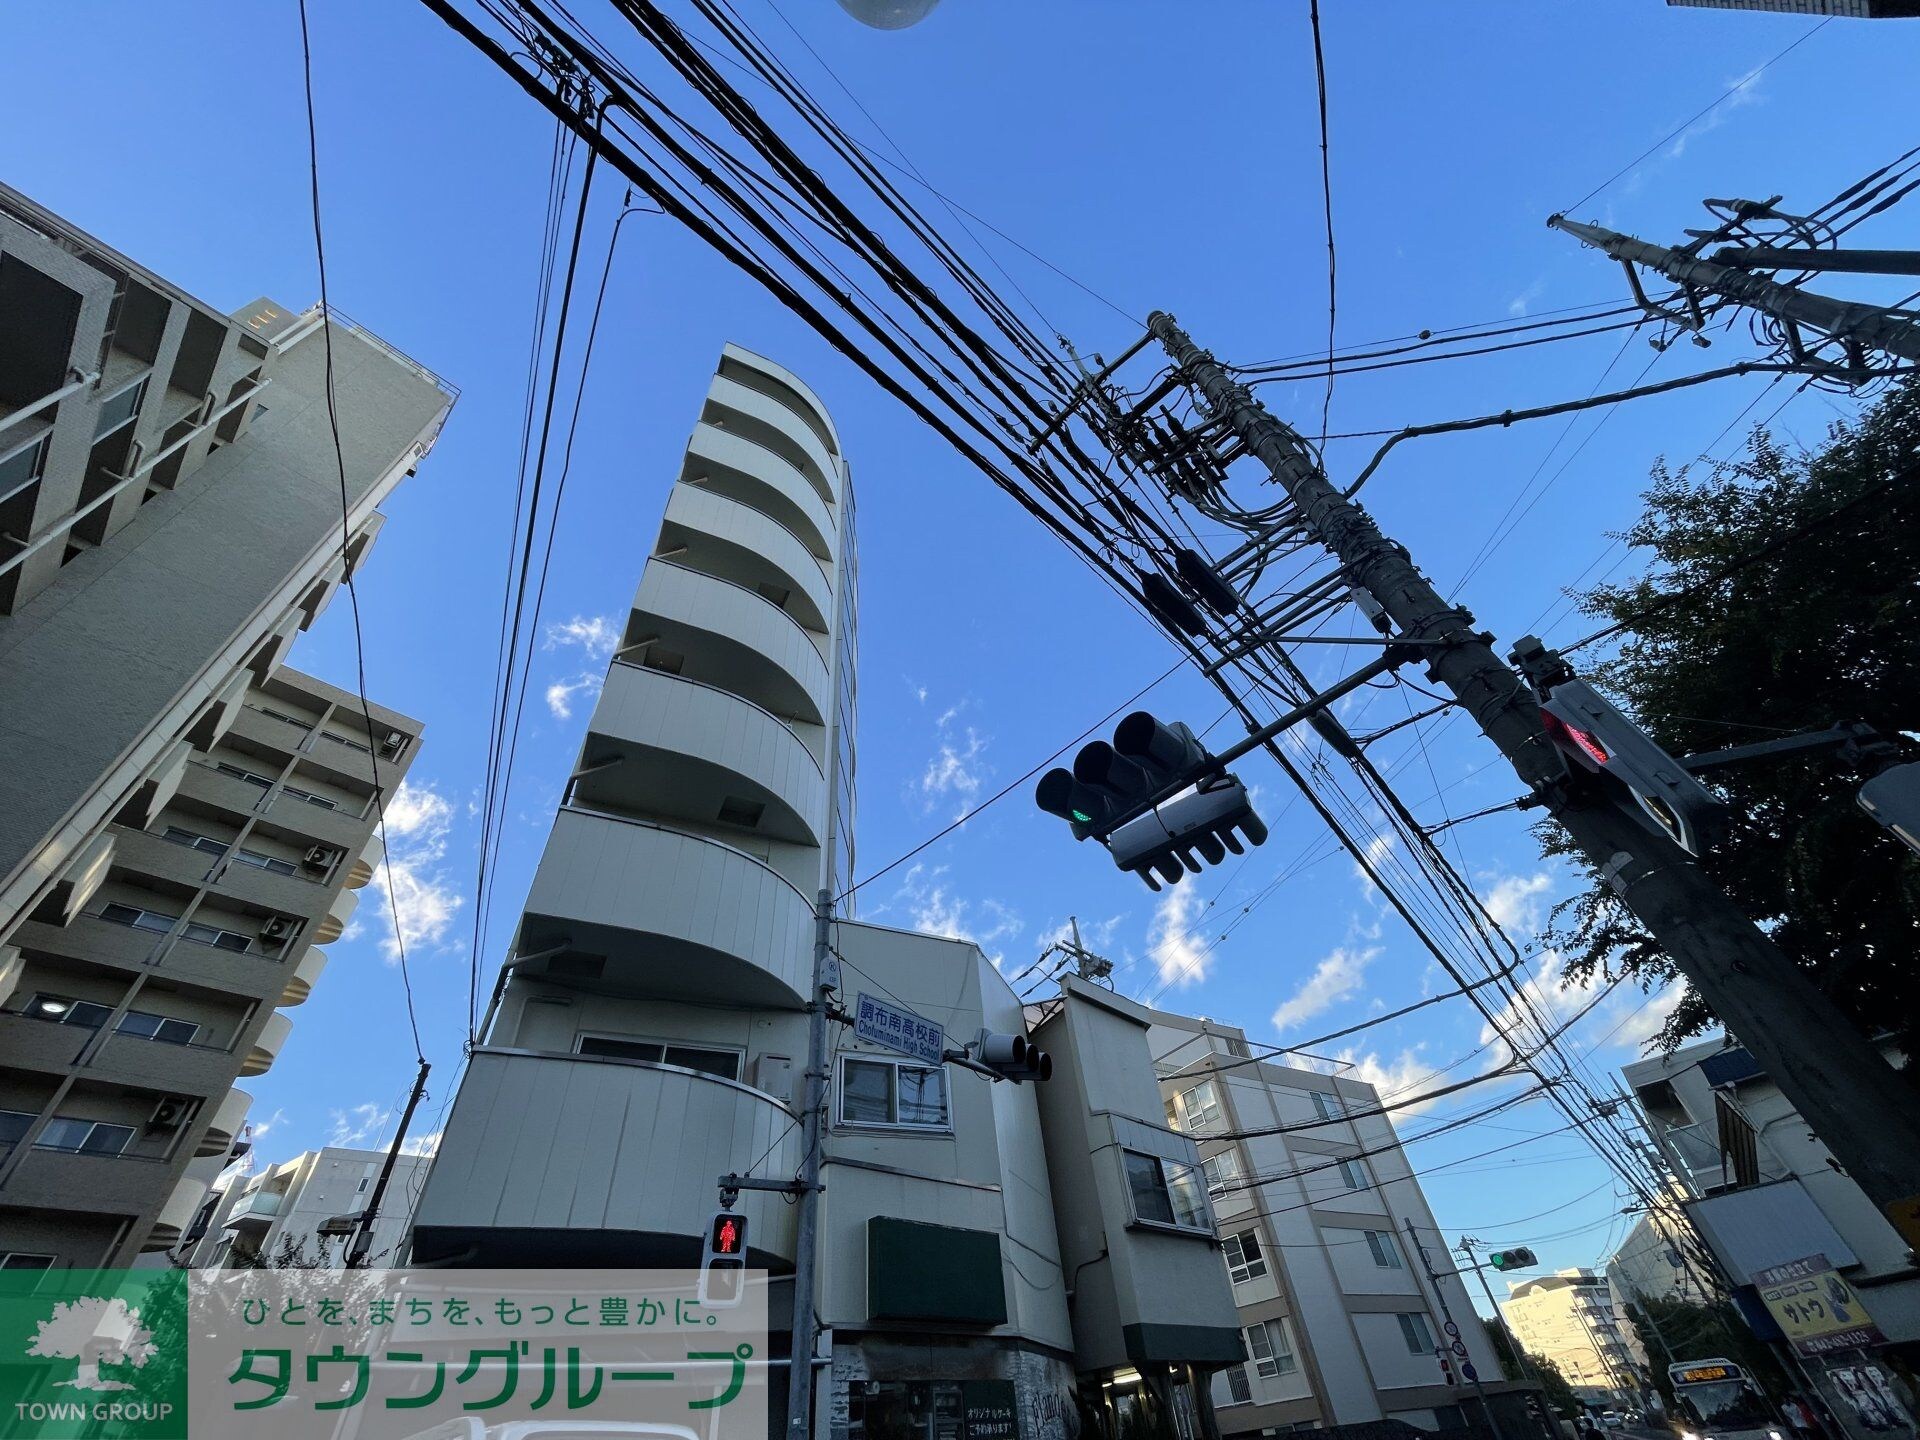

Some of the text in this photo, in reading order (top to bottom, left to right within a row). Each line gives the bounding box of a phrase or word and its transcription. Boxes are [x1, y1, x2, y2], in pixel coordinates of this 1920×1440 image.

[859, 1020, 939, 1060] Chofuminami High School
[860, 1001, 940, 1047] 調布南高校前
